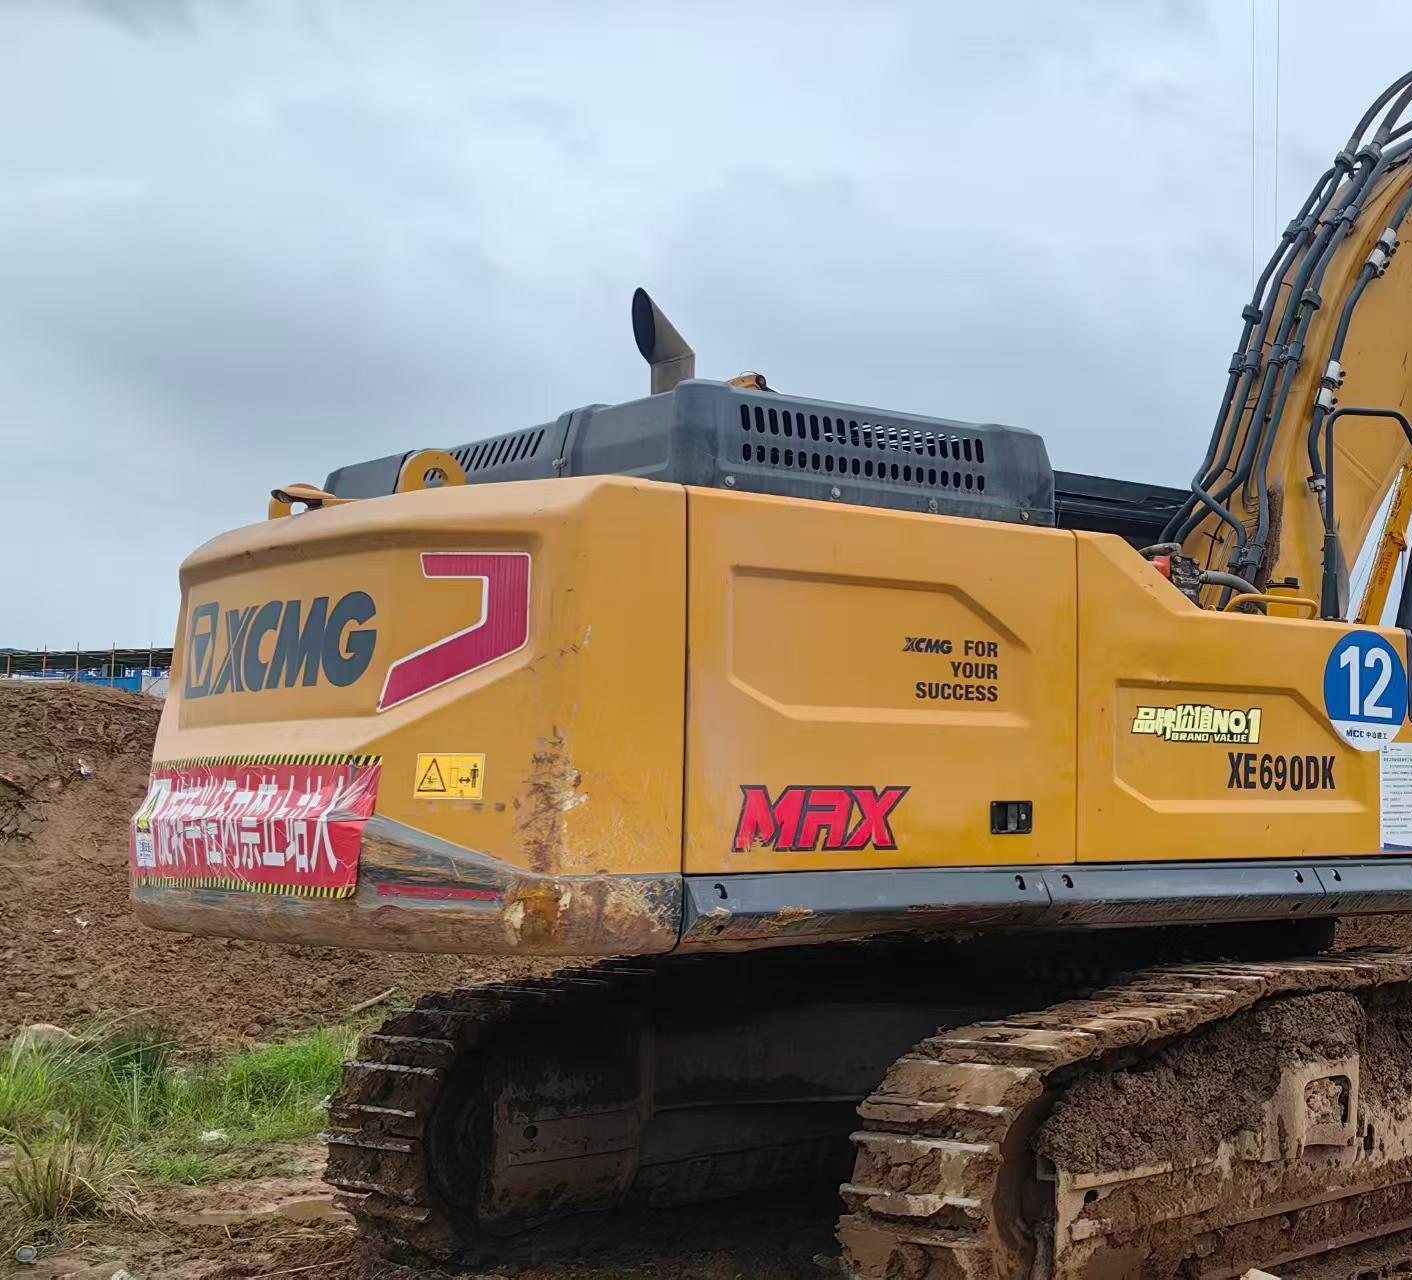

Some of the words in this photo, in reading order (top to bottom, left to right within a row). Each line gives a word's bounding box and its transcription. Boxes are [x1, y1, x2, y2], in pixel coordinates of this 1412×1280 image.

[214, 590, 378, 695] XCMG
[902, 637, 952, 655] XCMG
[964, 639, 999, 658] FOR
[950, 661, 999, 680] YOUR
[1340, 645, 1393, 719] 12
[915, 682, 999, 702] SUCCESS
[1171, 733, 1209, 742] BRAND
[1213, 733, 1248, 743] VALUE
[1227, 752, 1336, 791] XE690DK
[731, 785, 911, 852] MAX
